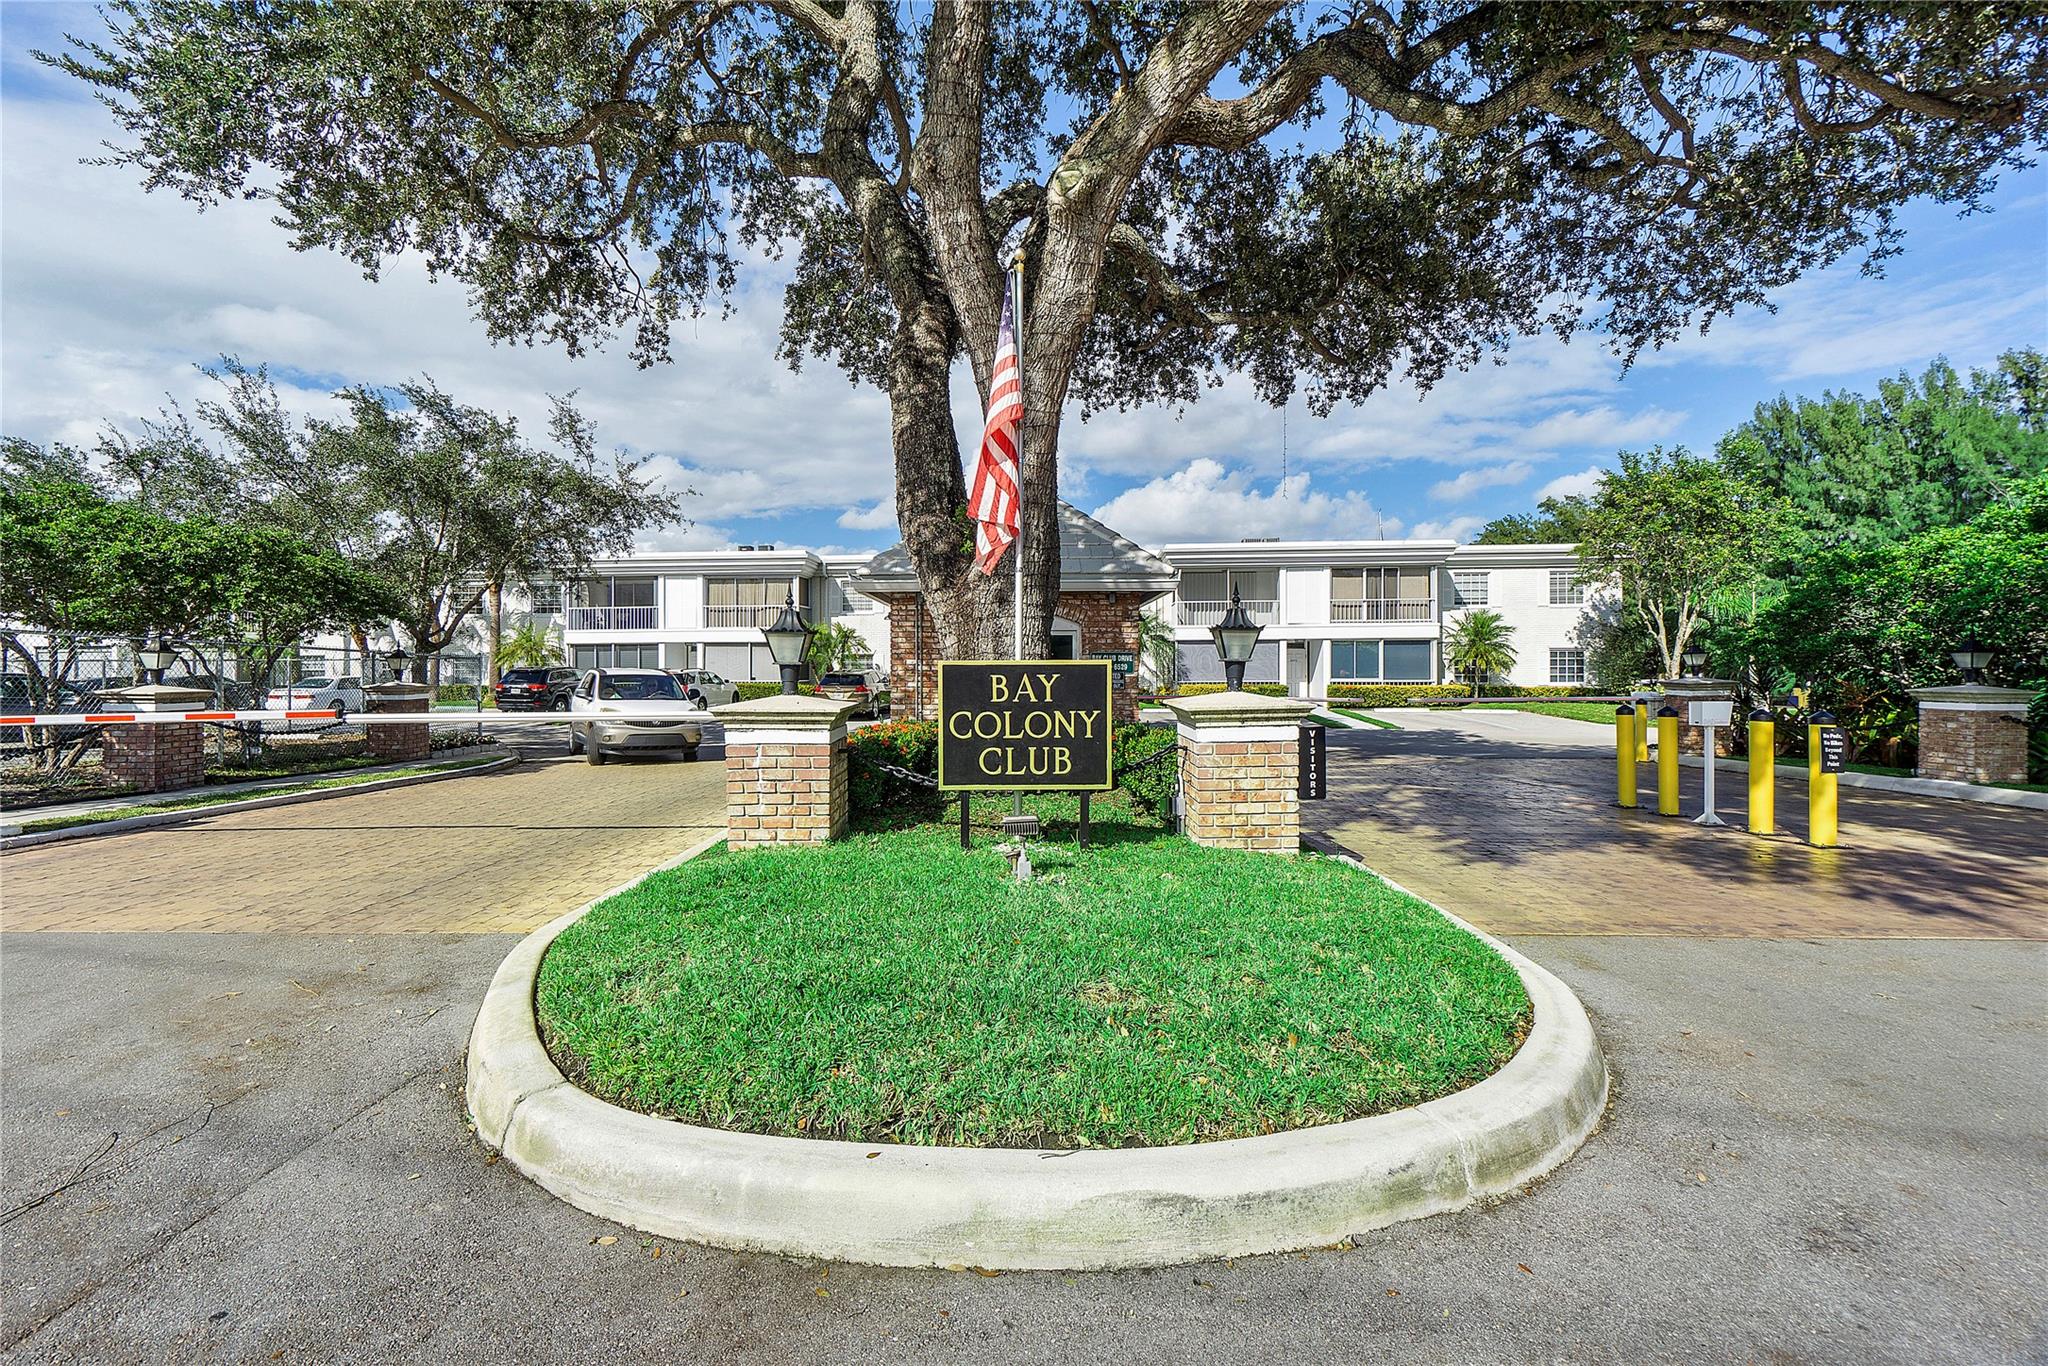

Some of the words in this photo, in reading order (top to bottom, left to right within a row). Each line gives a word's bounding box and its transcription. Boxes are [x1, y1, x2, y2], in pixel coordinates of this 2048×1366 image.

[990, 673, 1061, 703] BAY
[949, 710, 1101, 740] COLONY
[978, 746, 1072, 776] CLUB
[1308, 729, 1317, 797] VISITORS
